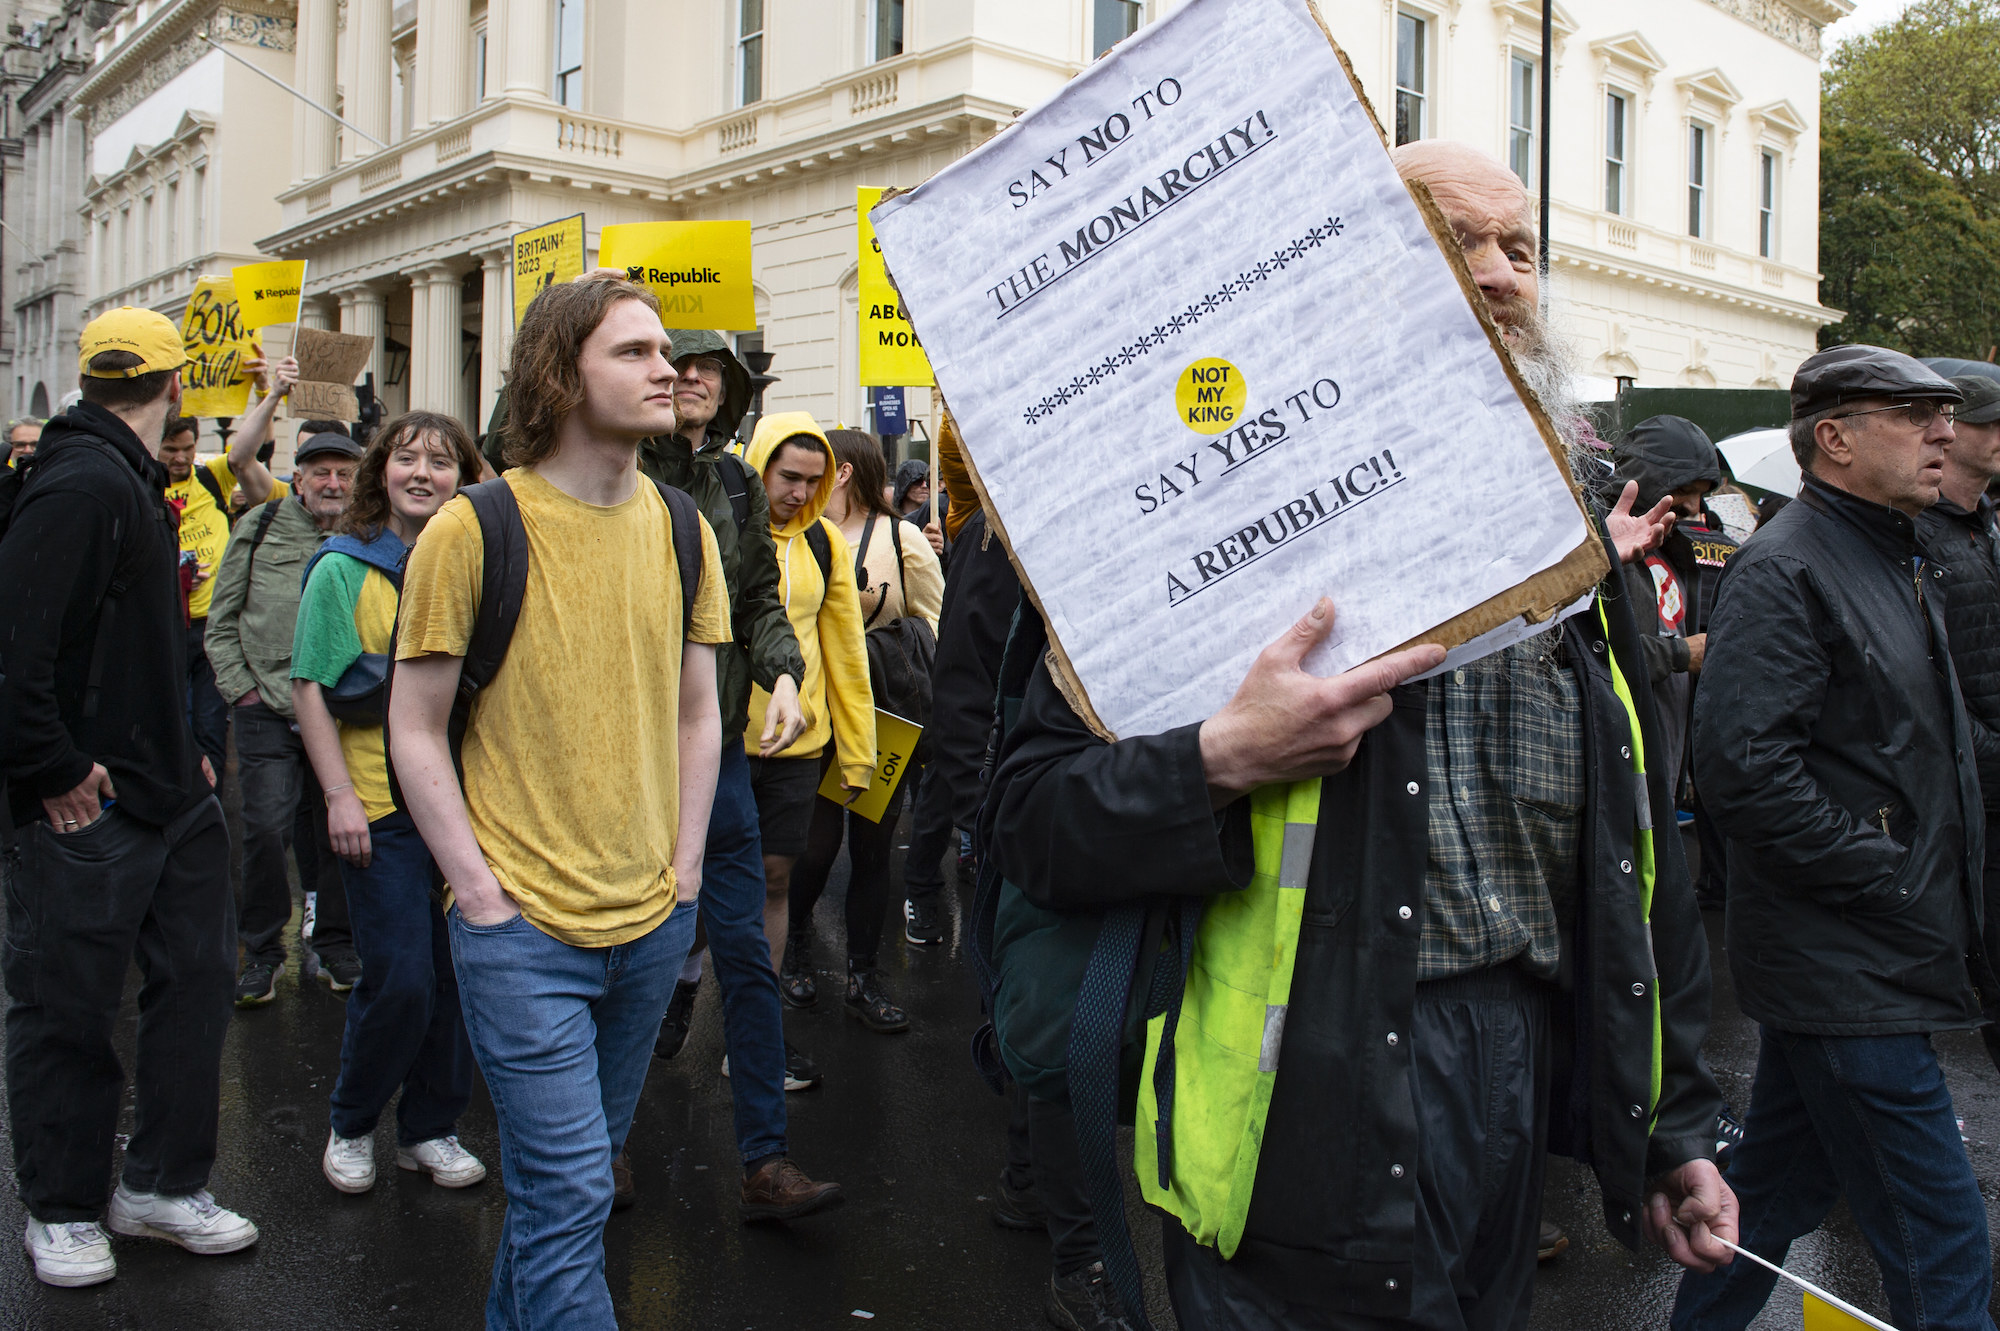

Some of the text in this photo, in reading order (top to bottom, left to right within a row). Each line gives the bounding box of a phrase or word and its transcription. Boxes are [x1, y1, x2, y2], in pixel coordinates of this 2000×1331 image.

[1008, 77, 1182, 210] SAY NO TO
[986, 109, 1274, 312] THE MONARCHY!
[517, 233, 559, 259] BRITAIN
[518, 257, 540, 276] 2023
[648, 267, 721, 287] Republic
[300, 339, 356, 360] NOT
[1192, 366, 1230, 383] NOT
[294, 384, 349, 408] ING
[1197, 386, 1225, 403] MY
[1188, 405, 1234, 423] KING
[1134, 378, 1341, 515] SAY YES TO
[1167, 449, 1401, 603] A REPUBLIC!!
[880, 752, 902, 786] NOT
